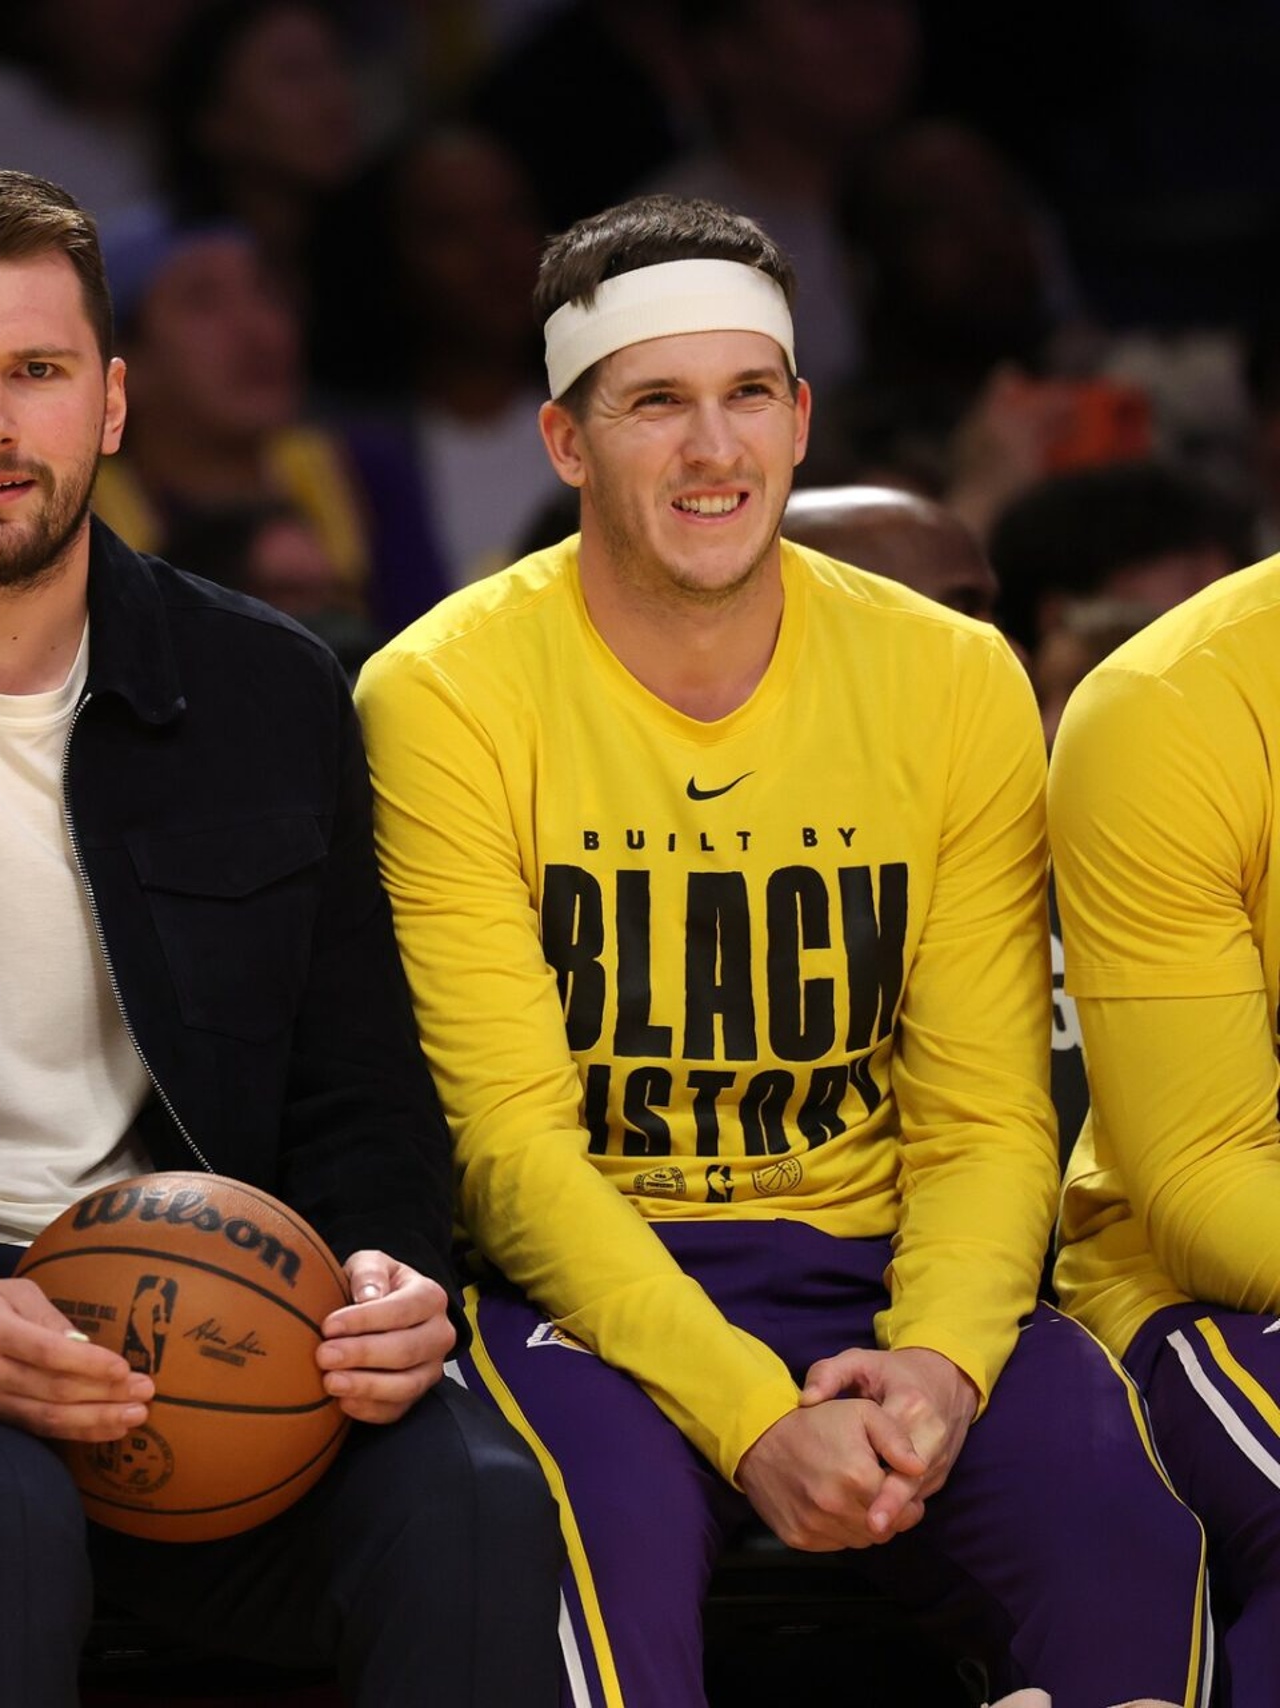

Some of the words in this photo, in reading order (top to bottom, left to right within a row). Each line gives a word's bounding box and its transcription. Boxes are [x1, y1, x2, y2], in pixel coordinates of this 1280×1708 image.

[583, 829, 751, 852] BUILT
[802, 827, 856, 847] BY
[541, 862, 908, 1062] BLACK
[585, 1055, 882, 1157] ISTORY
[72, 1186, 302, 1289] Wilson
